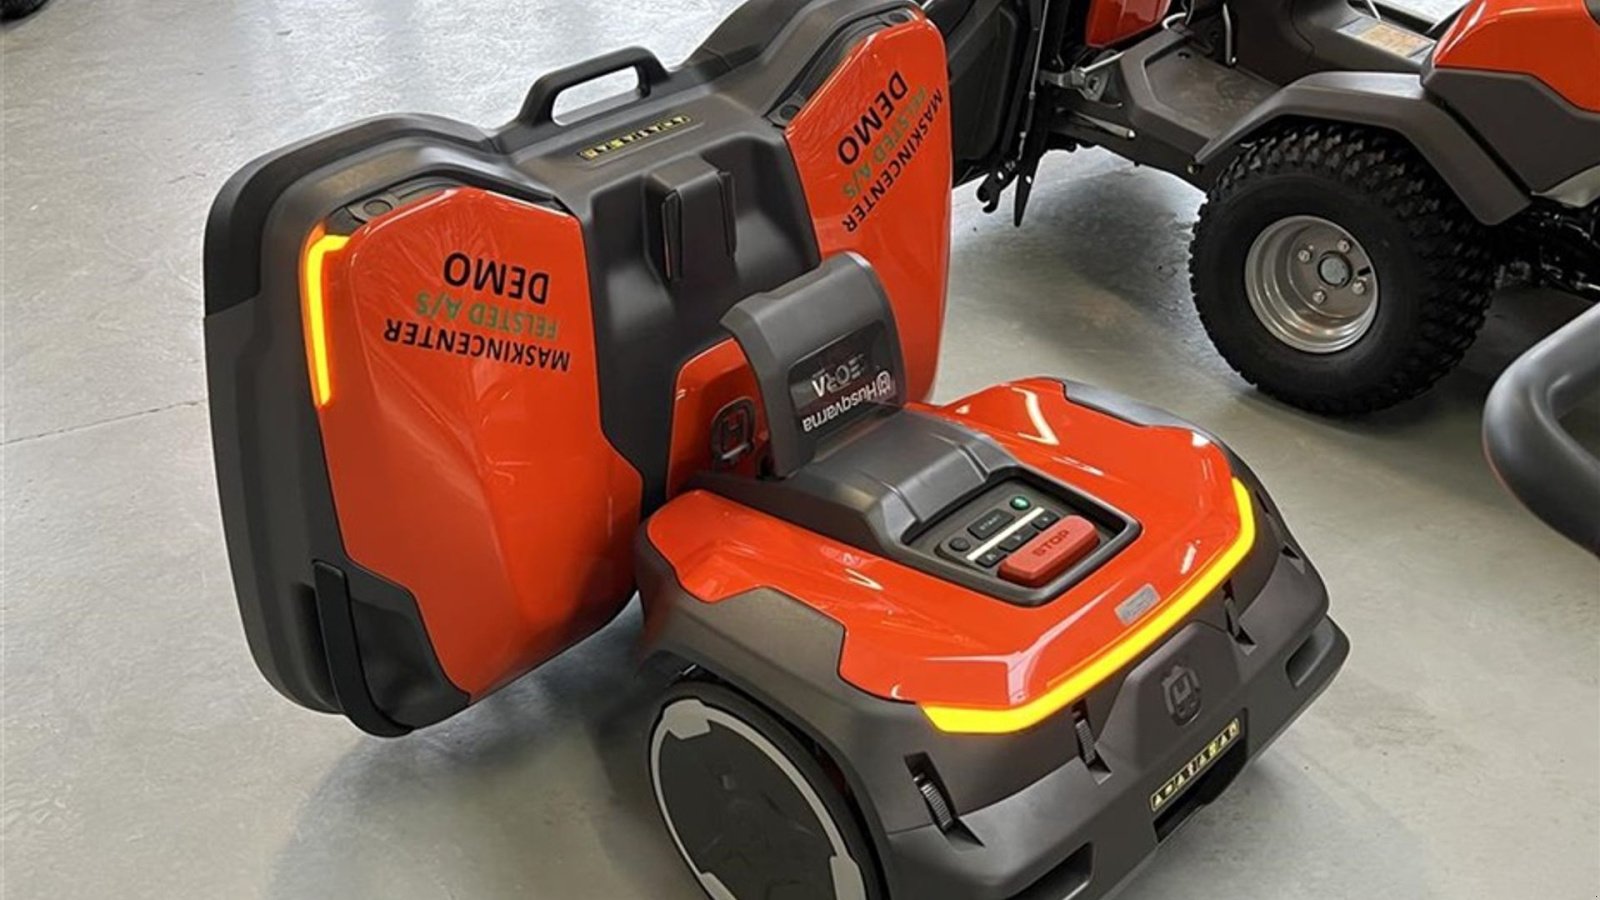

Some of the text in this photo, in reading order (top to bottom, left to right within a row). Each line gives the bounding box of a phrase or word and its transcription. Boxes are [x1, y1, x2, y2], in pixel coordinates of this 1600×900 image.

[838, 71, 908, 165] DEMO
[841, 88, 943, 232] MASKINCENTER
[842, 162, 871, 198] A/S
[444, 252, 549, 305] DEMO
[416, 291, 558, 340] FELSTED A/S
[383, 318, 571, 372] MASKINCENTER
[802, 381, 877, 432] Husqvarna
[1032, 528, 1070, 557] STOP
